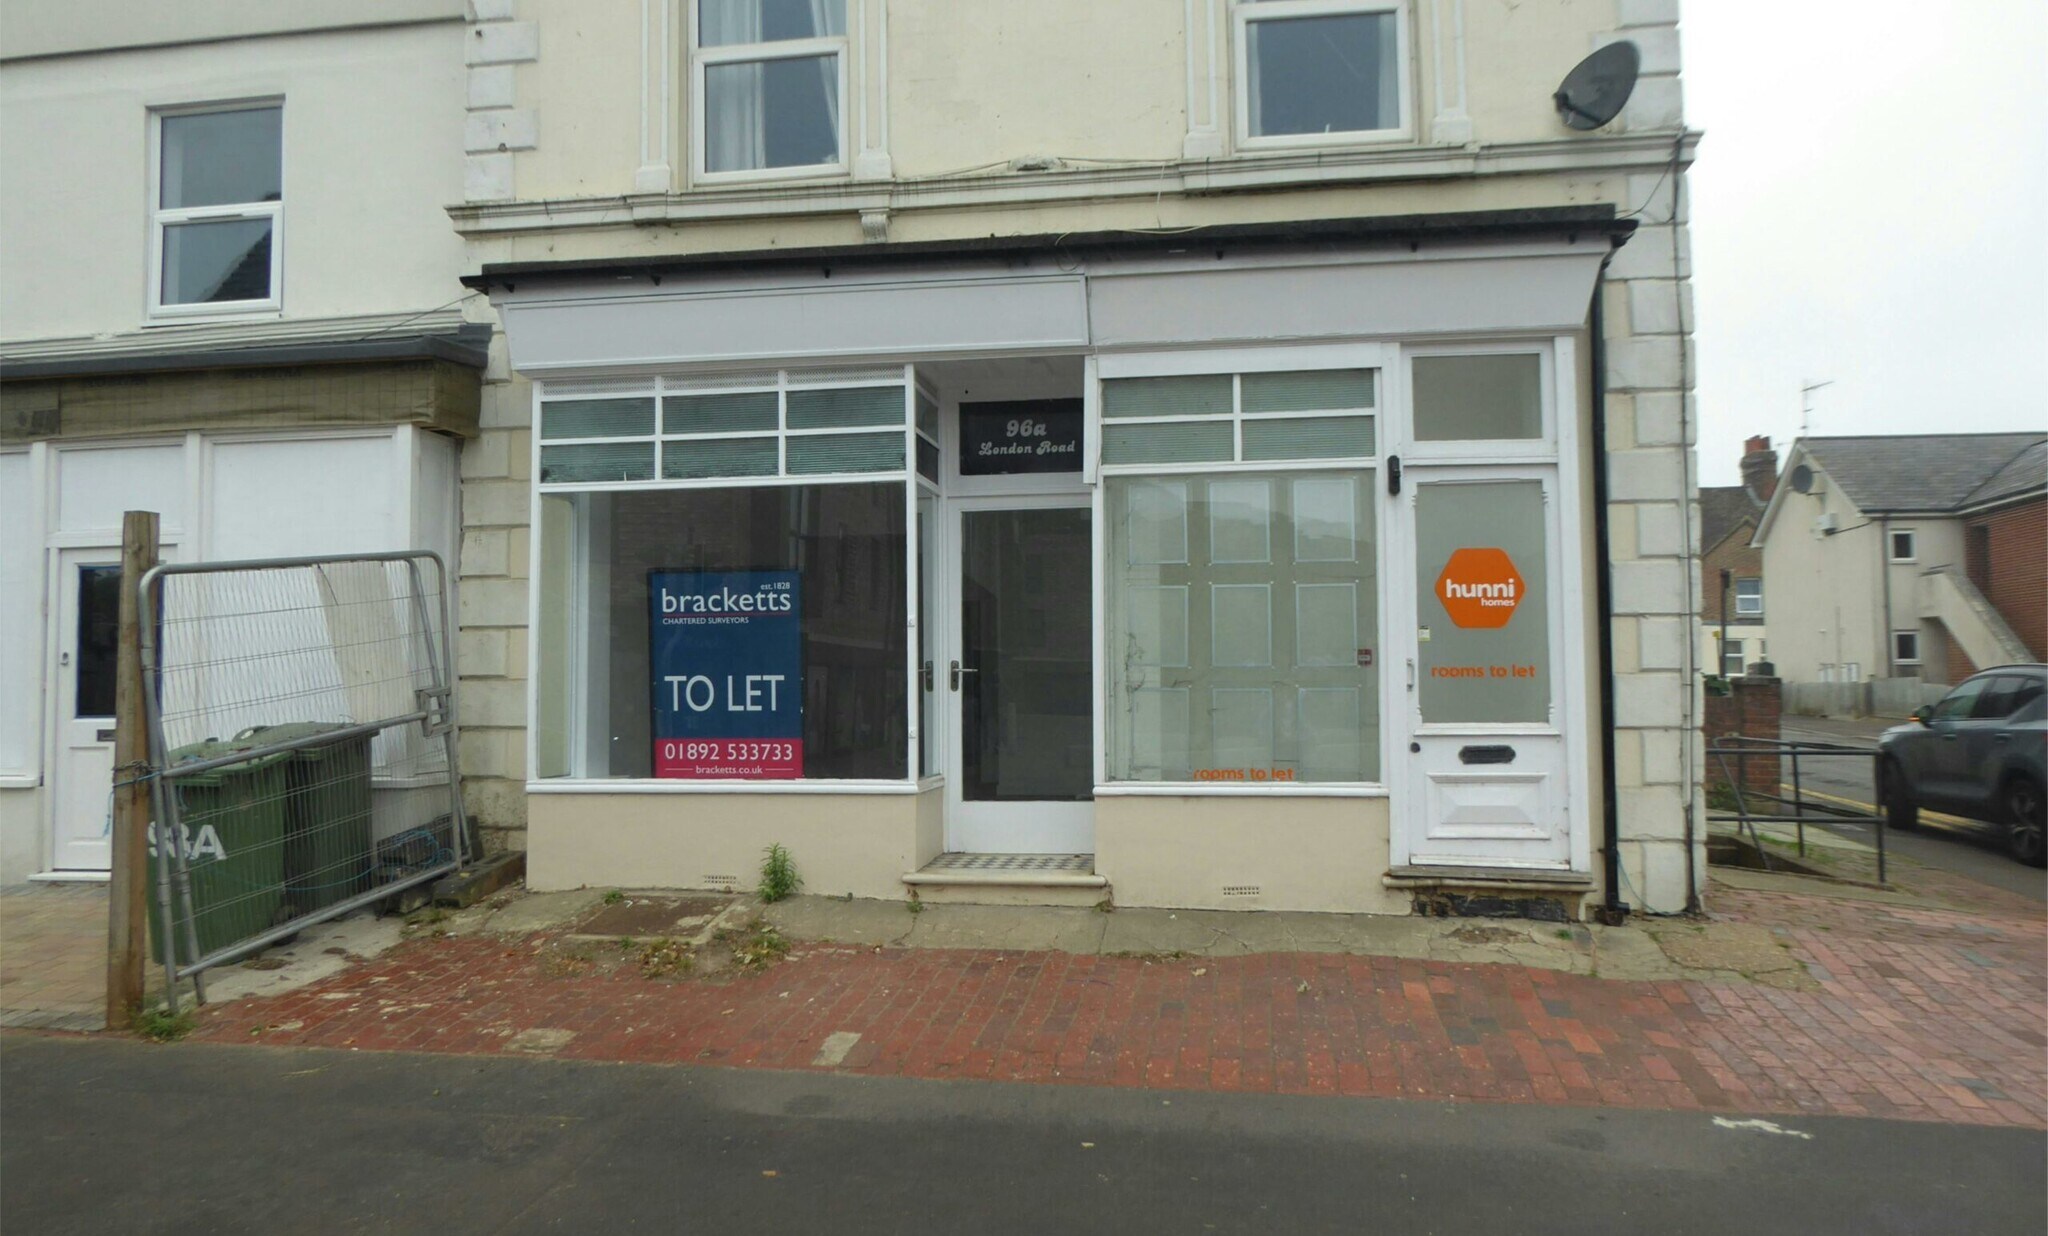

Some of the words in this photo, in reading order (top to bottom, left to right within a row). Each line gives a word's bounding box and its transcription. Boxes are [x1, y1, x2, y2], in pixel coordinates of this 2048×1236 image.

[1006, 419, 1047, 437] 96a
[979, 442, 1032, 455] London
[1037, 440, 1075, 455] Road
[1446, 578, 1515, 598] hunni
[661, 587, 791, 613] bracketts
[1481, 598, 1515, 607] homes
[662, 617, 707, 625] CHARTERED
[708, 616, 749, 624] SURVEYORS
[1432, 667, 1484, 678] rooms
[1489, 665, 1507, 678] to
[1512, 664, 1535, 677] let
[664, 675, 715, 712] TO
[727, 674, 785, 711] LET
[665, 743, 720, 760] 01892
[727, 743, 793, 760] 533733
[695, 765, 763, 774] bracketts.co.uk
[1194, 768, 1244, 780] rooms
[1249, 768, 1266, 780] to
[1271, 767, 1294, 781] let
